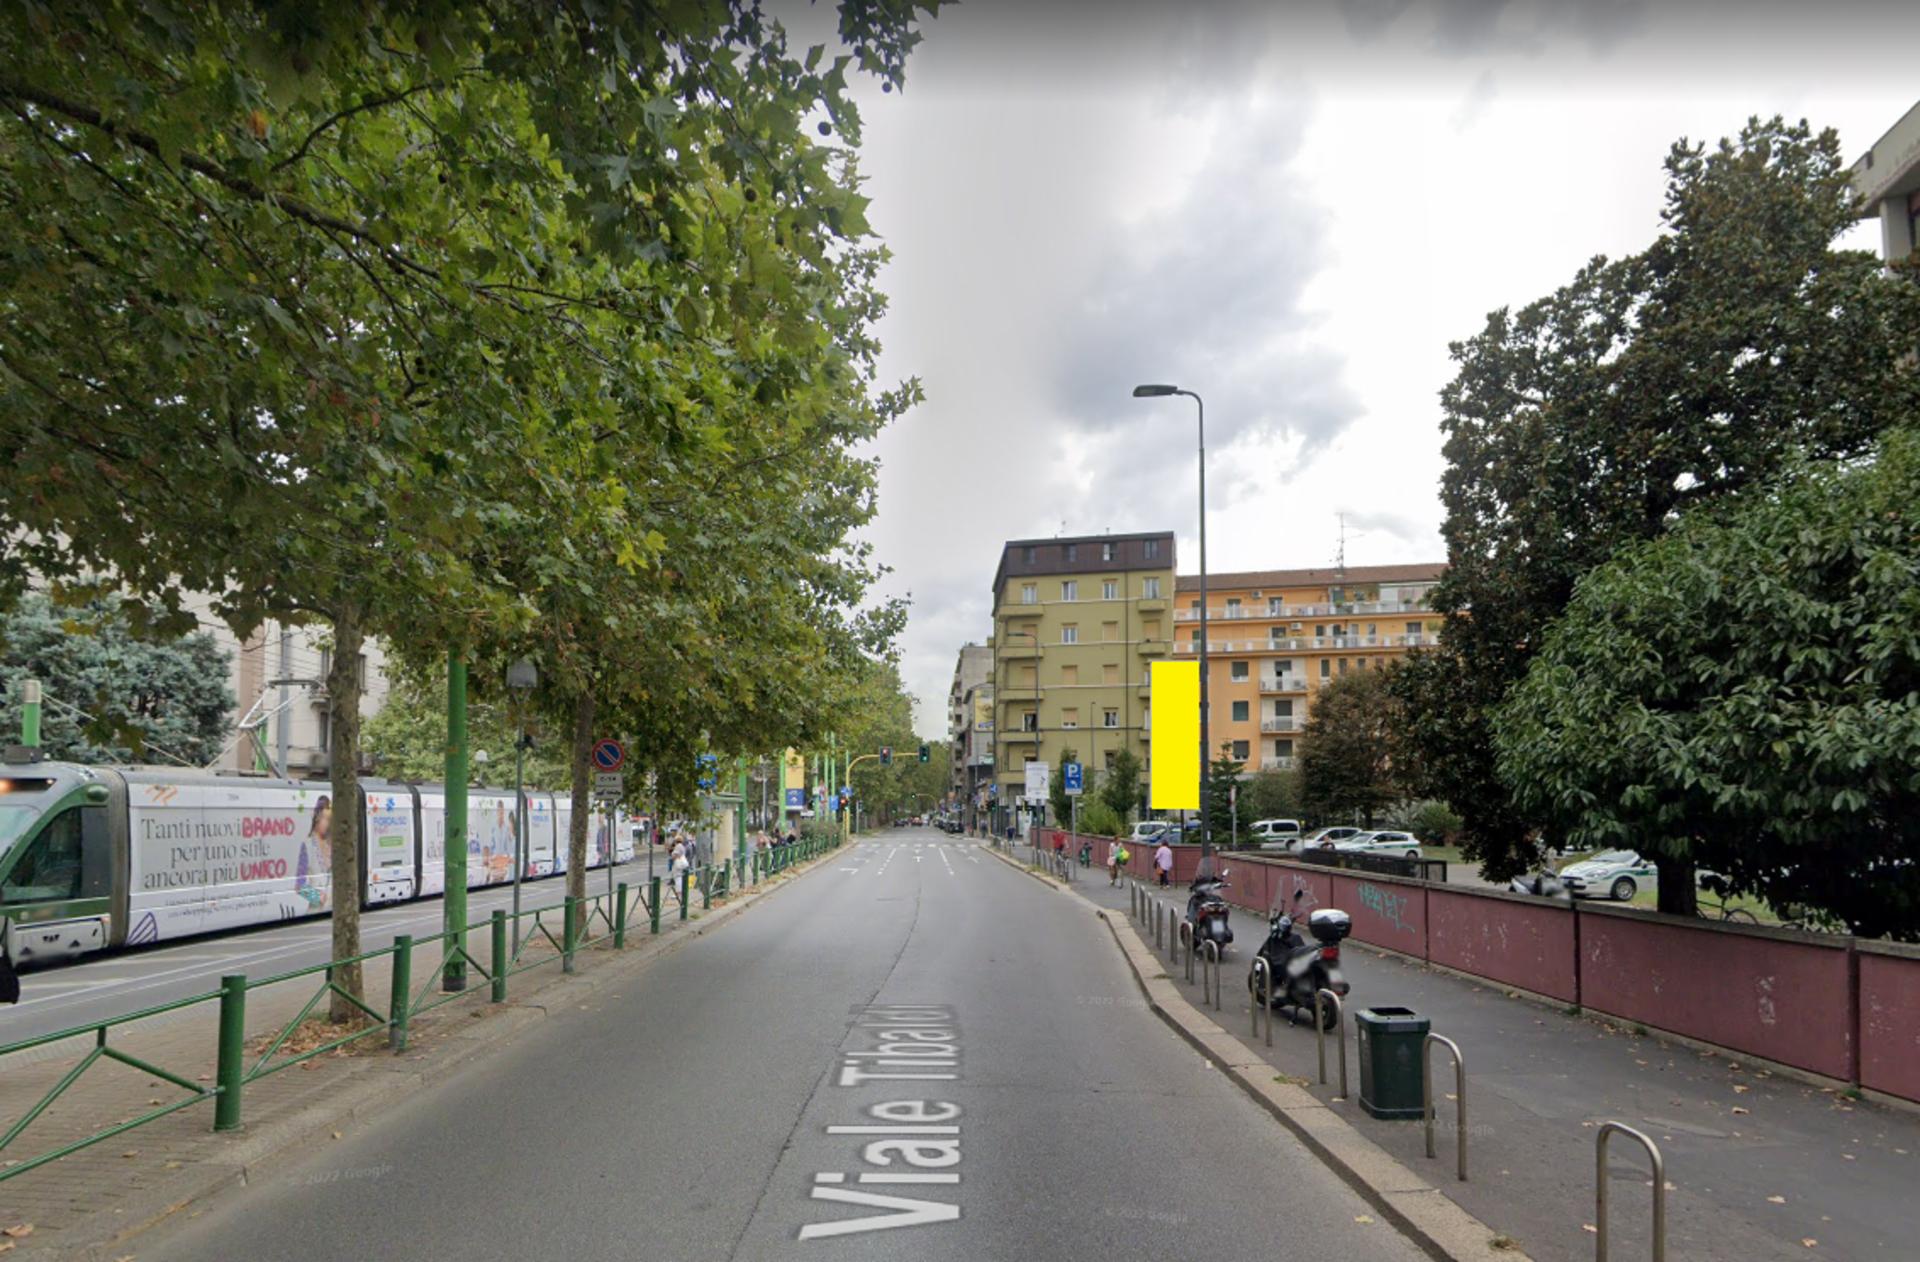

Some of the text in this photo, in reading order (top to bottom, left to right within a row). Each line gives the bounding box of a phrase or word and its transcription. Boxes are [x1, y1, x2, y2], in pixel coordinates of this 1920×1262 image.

[1068, 764, 1078, 778] P
[141, 816, 295, 840] Tanti nuovi BRAND
[170, 839, 271, 869] per uno stile
[143, 858, 288, 889] ancora più UNICO
